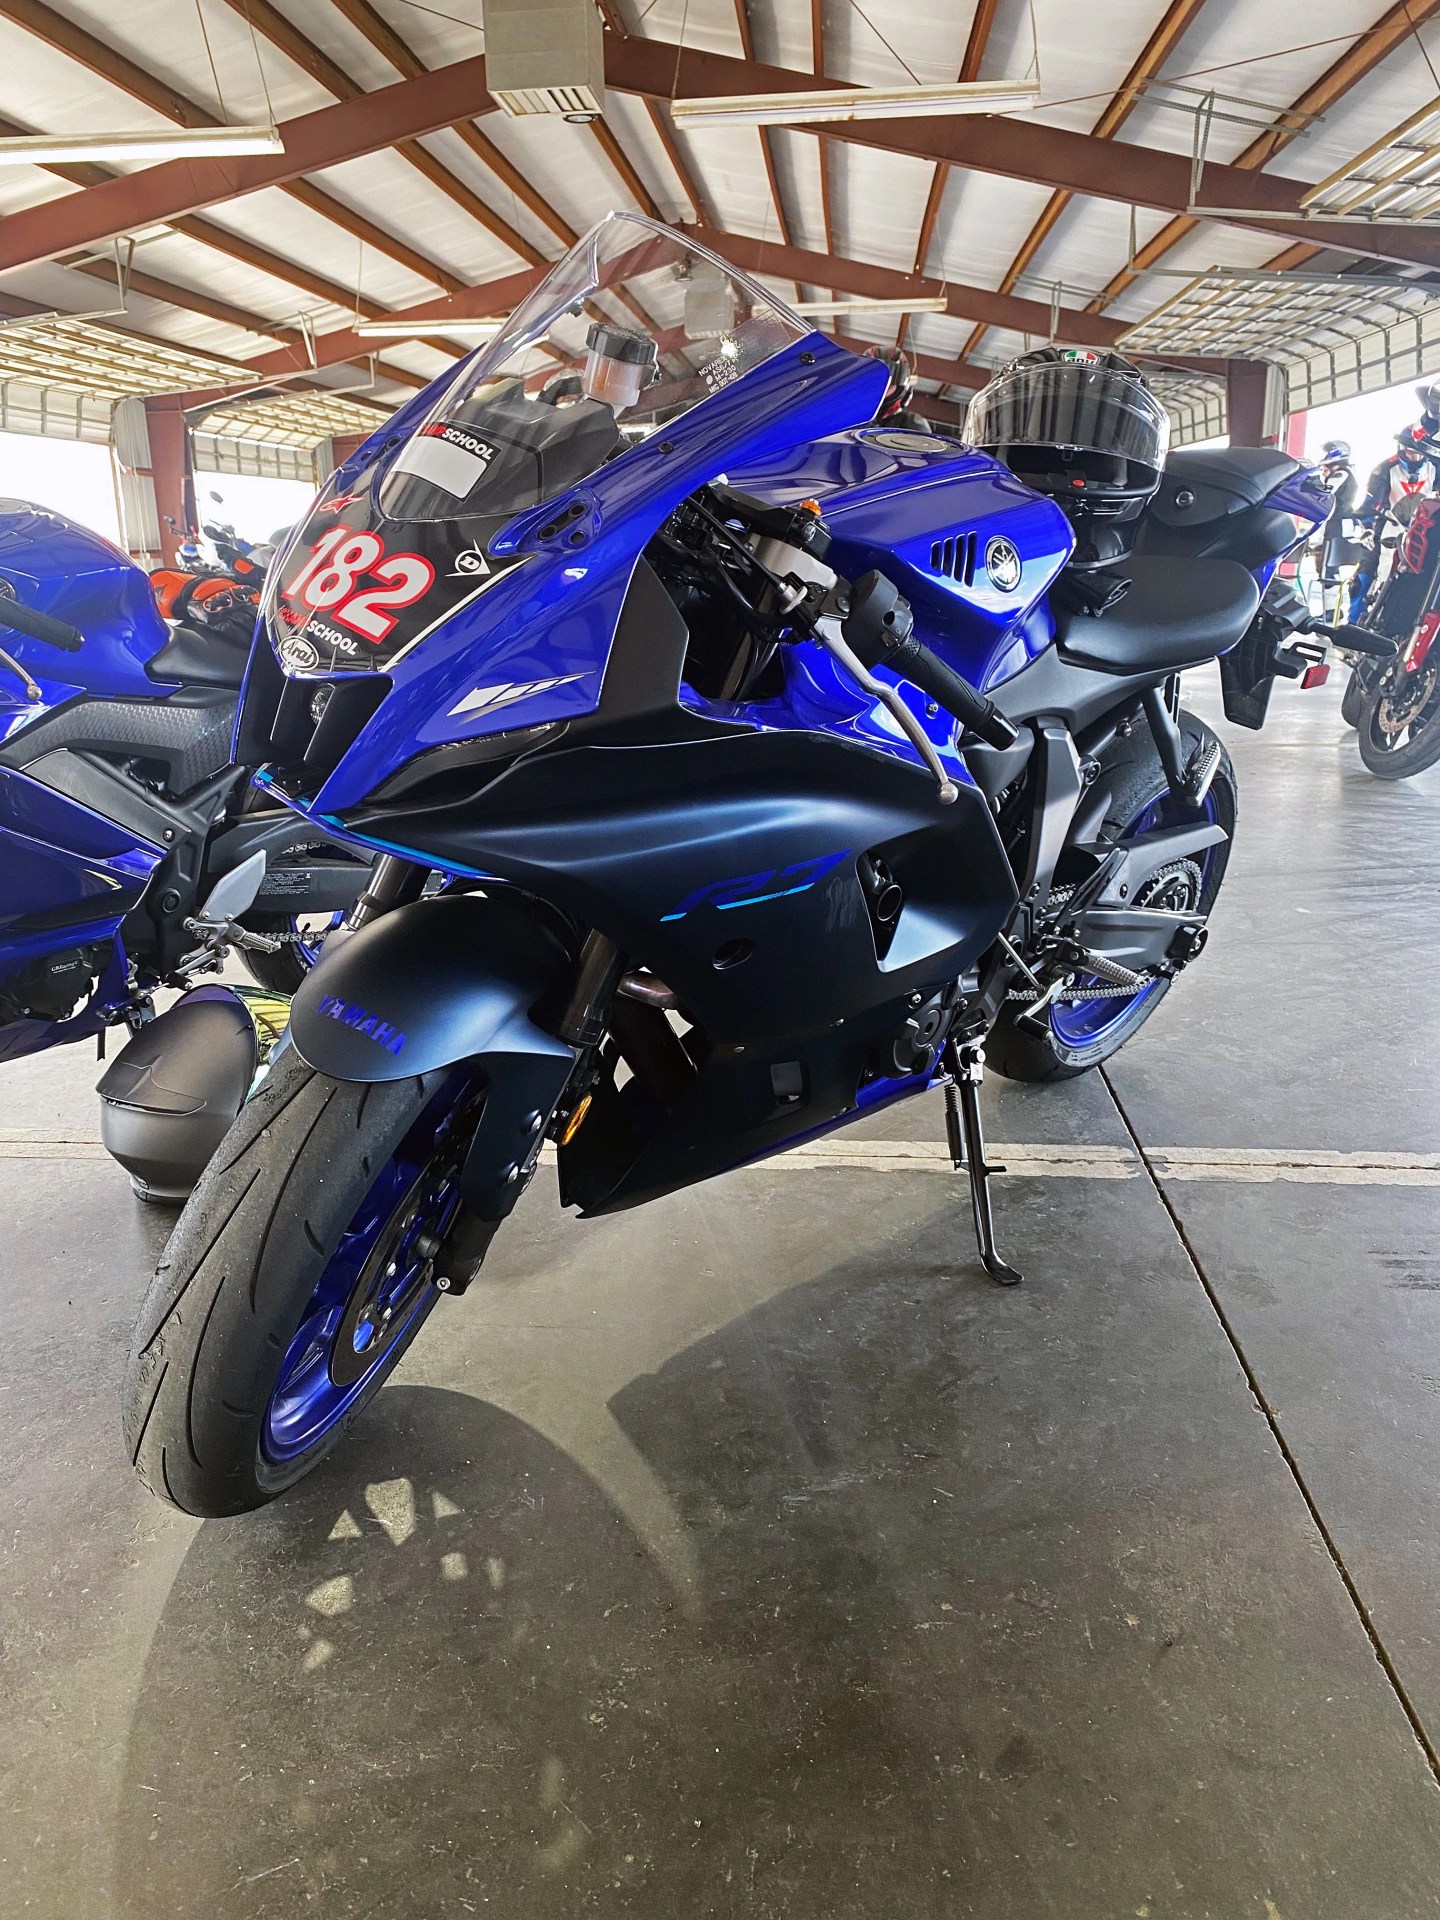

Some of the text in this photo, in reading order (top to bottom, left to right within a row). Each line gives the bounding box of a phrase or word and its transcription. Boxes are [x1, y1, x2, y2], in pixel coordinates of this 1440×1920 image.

[698, 356, 728, 377] NOVAREX
[714, 364, 737, 382] M-230
[281, 524, 435, 645] 182
[281, 640, 313, 664] Arai
[315, 994, 408, 1056] YAMAHA
